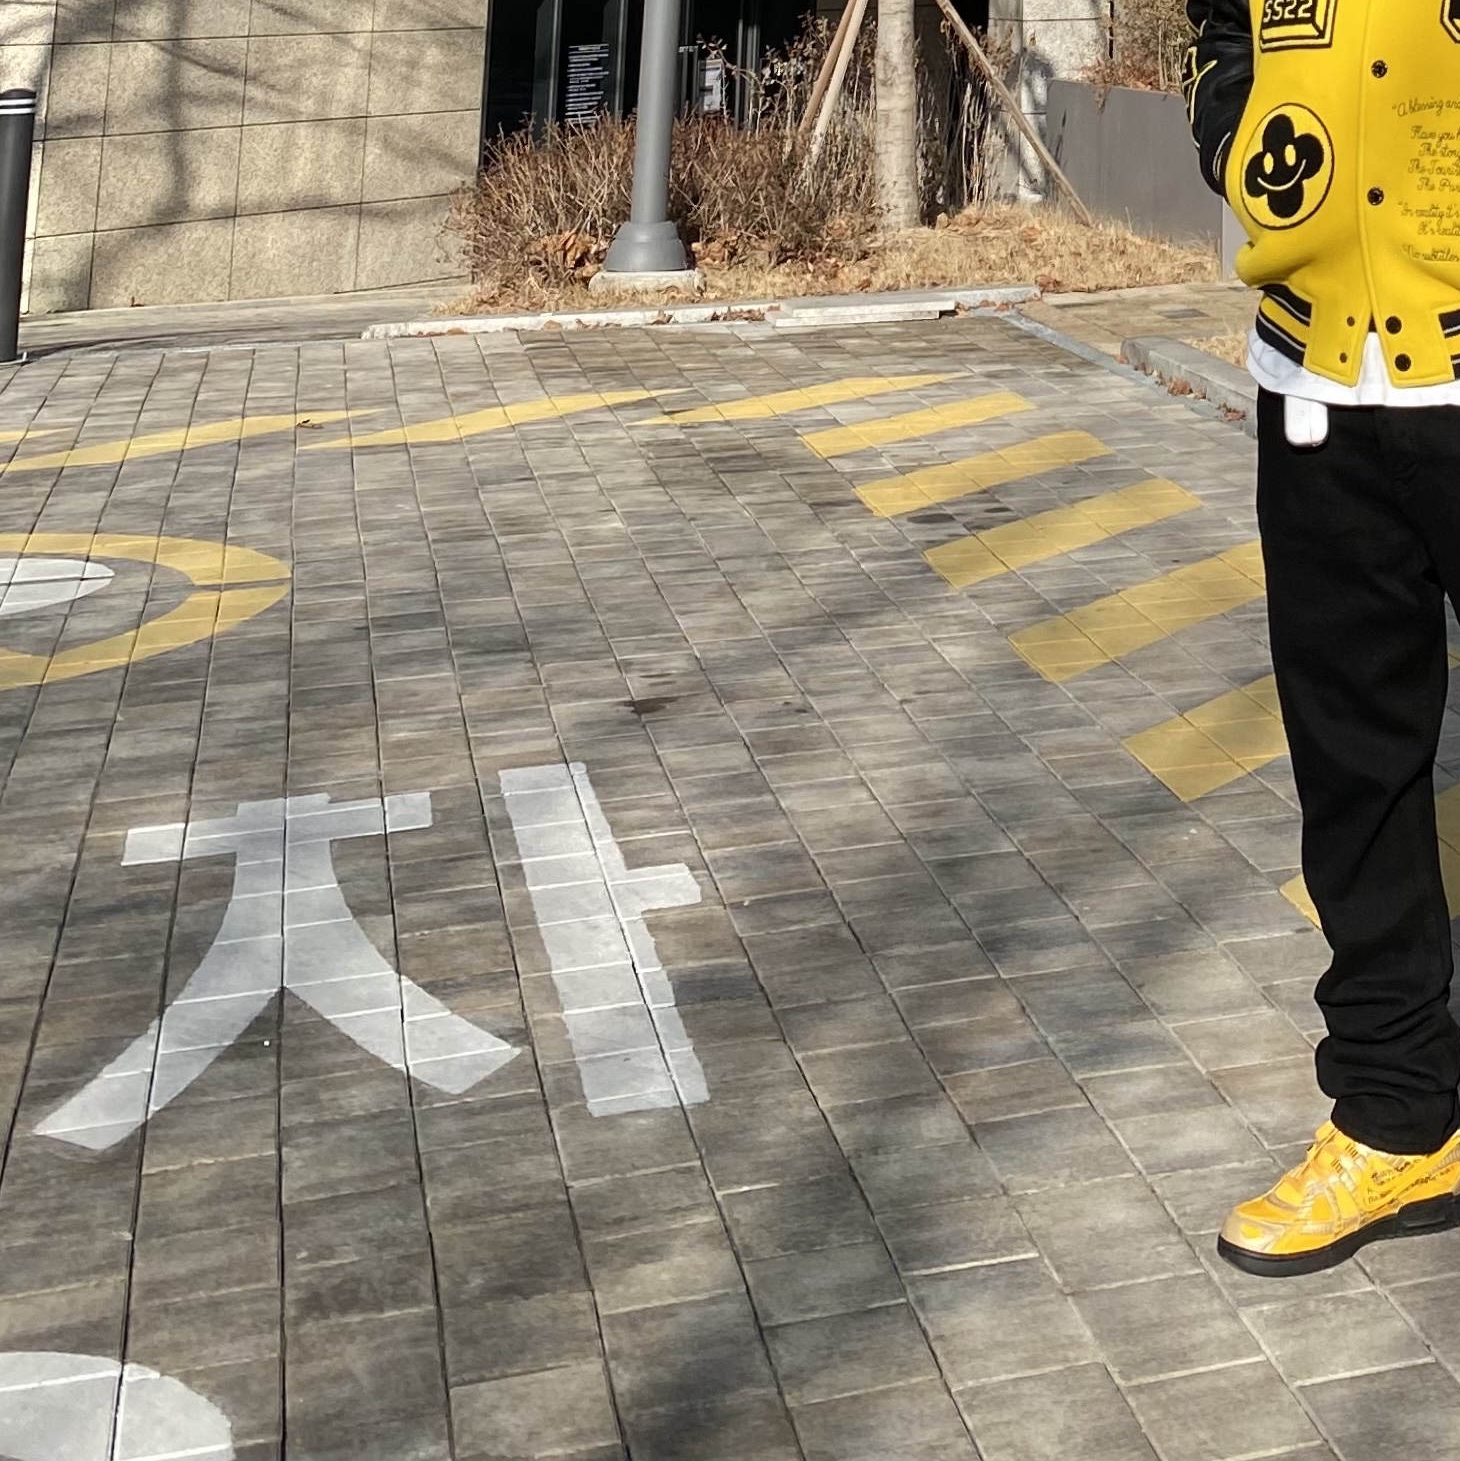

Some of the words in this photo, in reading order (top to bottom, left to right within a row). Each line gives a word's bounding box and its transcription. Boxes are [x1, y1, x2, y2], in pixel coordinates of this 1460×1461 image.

[1436, 132, 1456, 148] you
[1418, 142, 1438, 157] The
[1416, 177, 1436, 191] The
